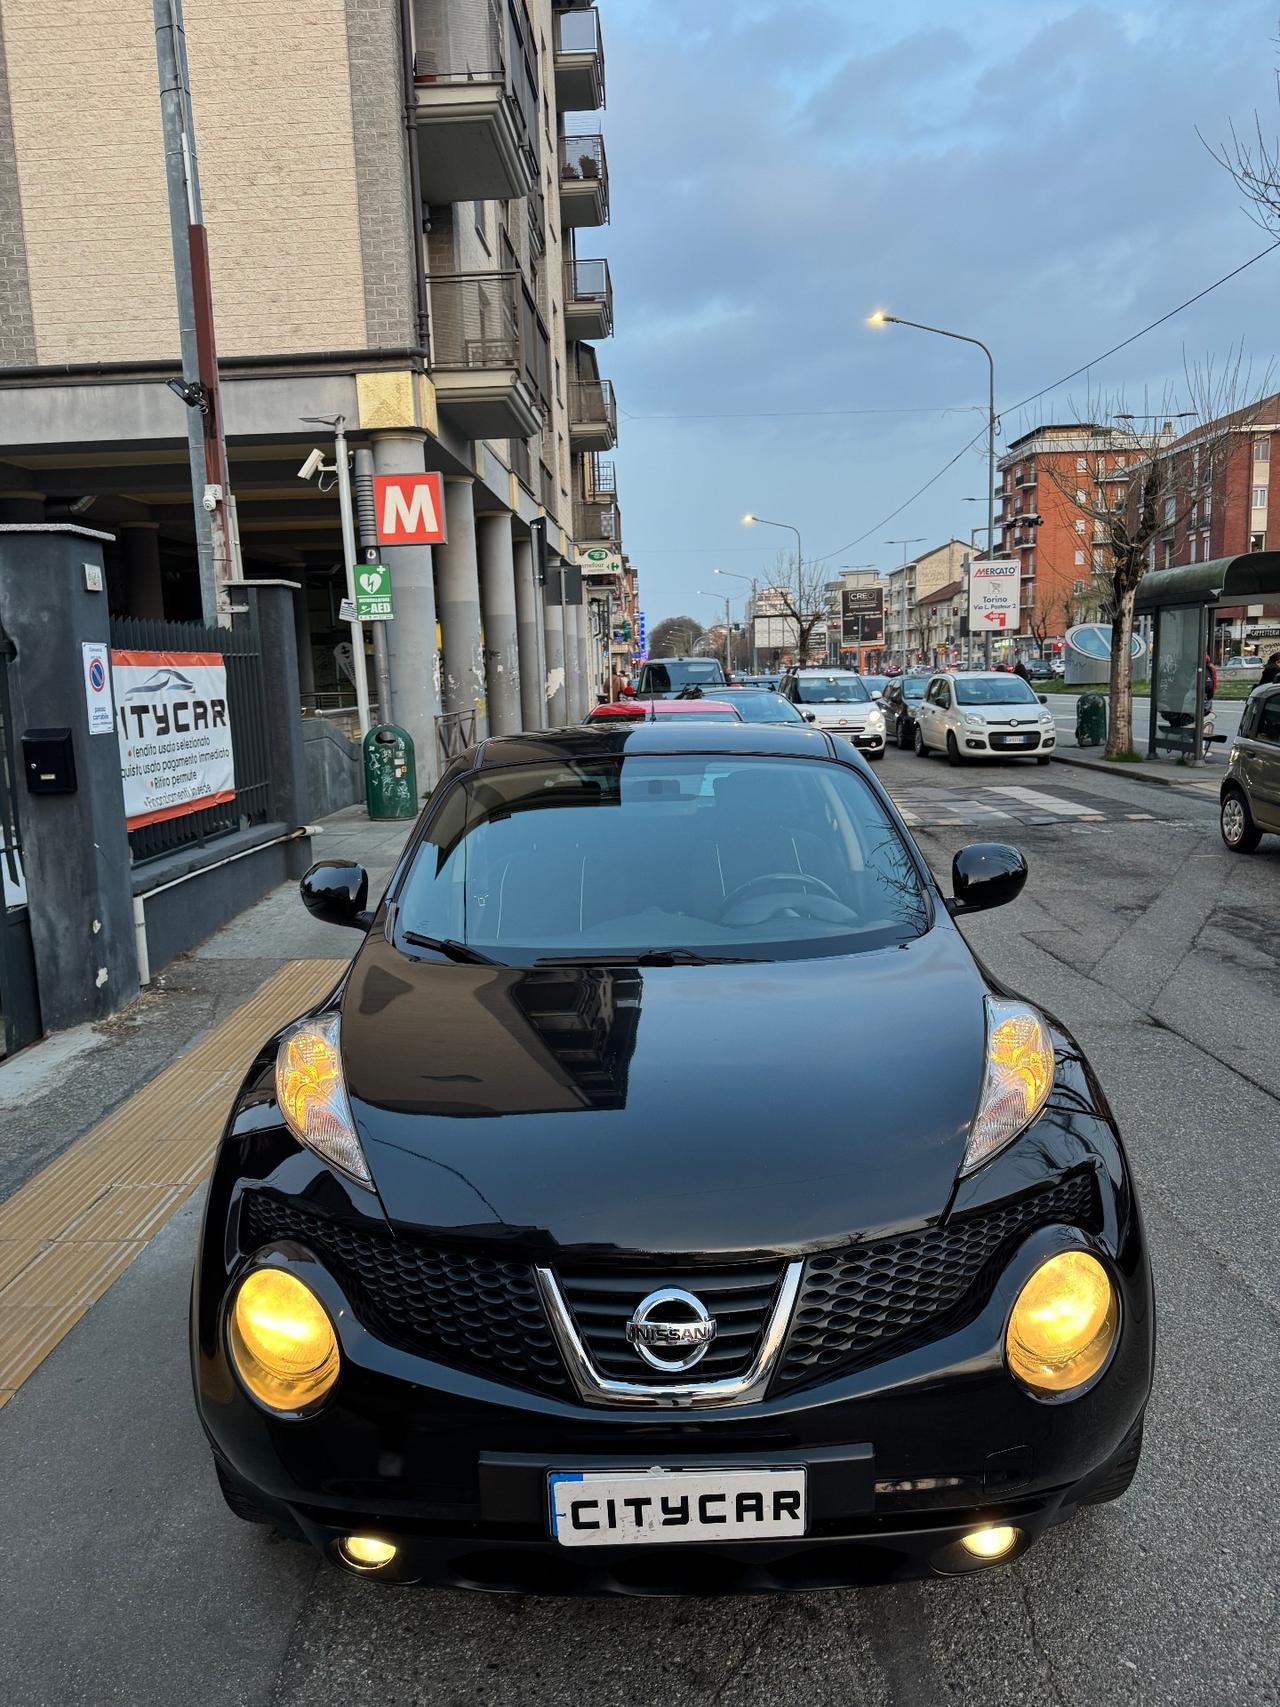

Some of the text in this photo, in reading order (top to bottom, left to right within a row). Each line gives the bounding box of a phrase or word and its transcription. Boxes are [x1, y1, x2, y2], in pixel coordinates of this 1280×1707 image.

[383, 484, 438, 533] M
[974, 567, 1016, 577] MERCATO
[370, 602, 391, 613] AED
[120, 699, 227, 740] ITYCAR
[176, 736, 211, 751] selezionato
[143, 760, 161, 773] usato
[162, 755, 198, 773] pagamento
[198, 748, 230, 761] immediato
[154, 770, 197, 790] Ritiro permute
[637, 1327, 707, 1341] NISSAN
[570, 1490, 801, 1530] CITYCAR
